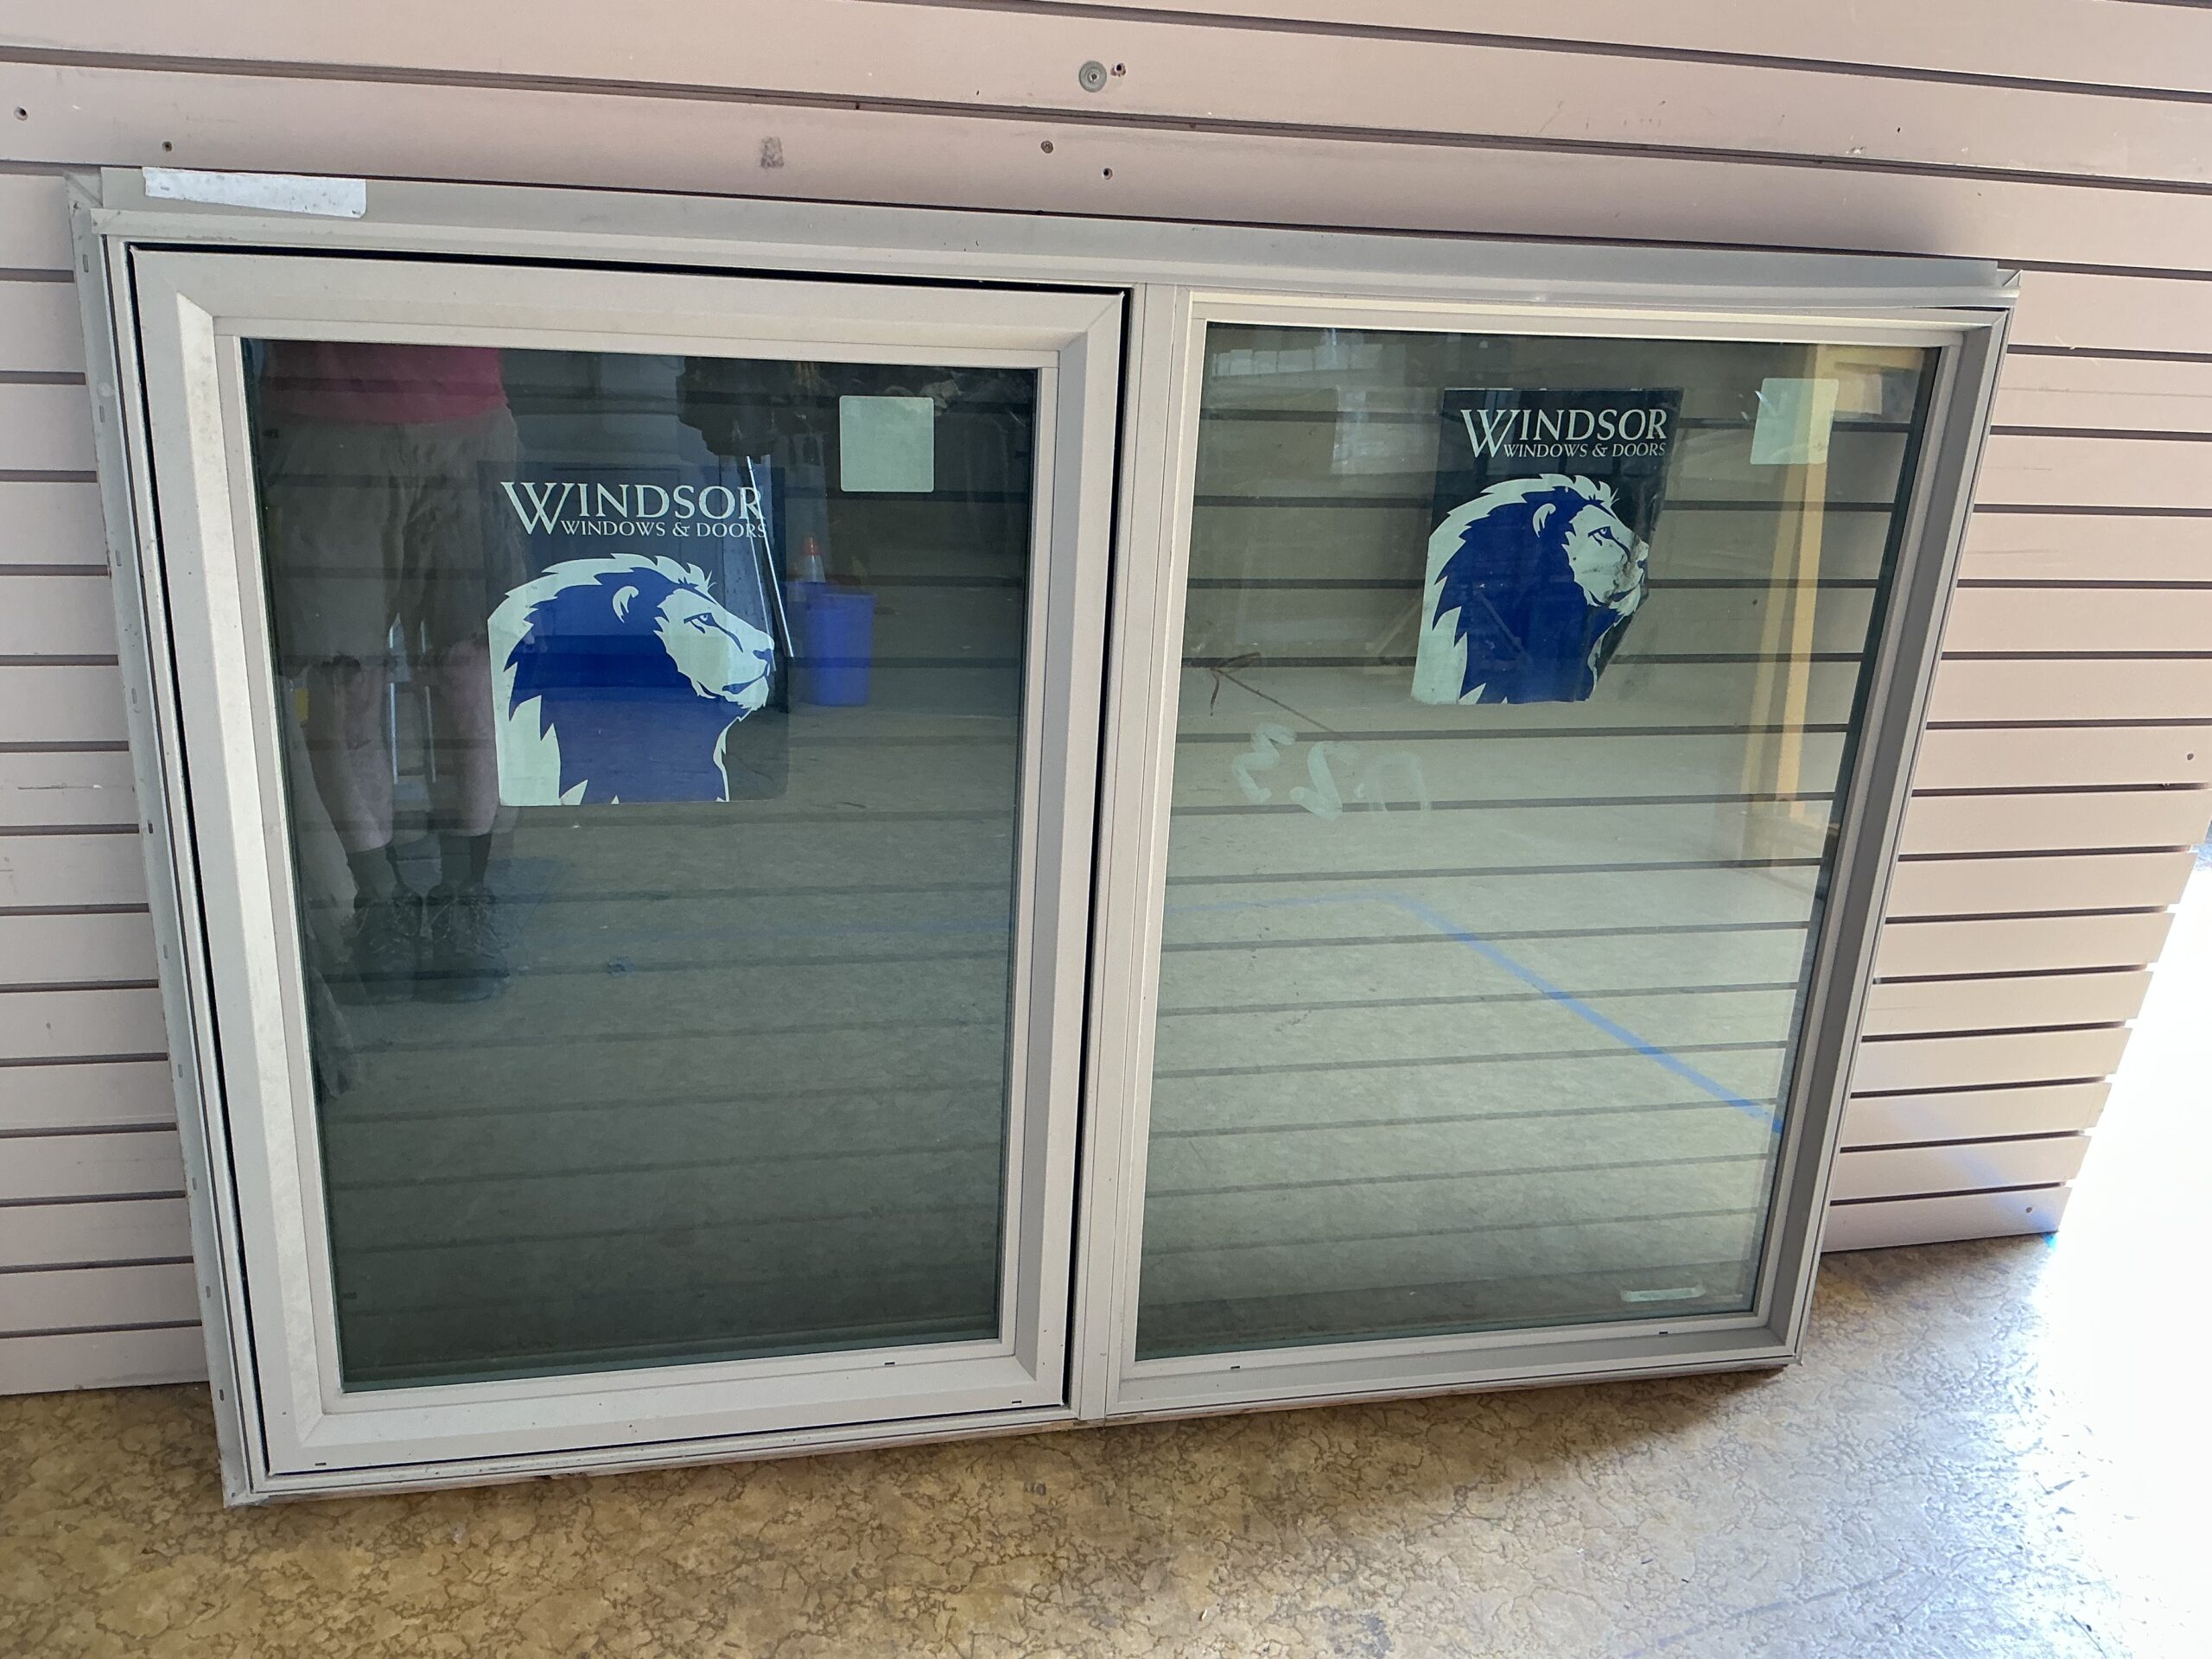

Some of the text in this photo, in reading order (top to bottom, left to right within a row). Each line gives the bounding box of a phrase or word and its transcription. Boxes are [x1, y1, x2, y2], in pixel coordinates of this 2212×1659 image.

[1460, 409, 1667, 458] WINDSOR
[1503, 442, 1666, 458] WINDOWS & DOORS
[500, 481, 766, 535] WINDSOR
[561, 520, 766, 538] WINDOWS & DOORS
